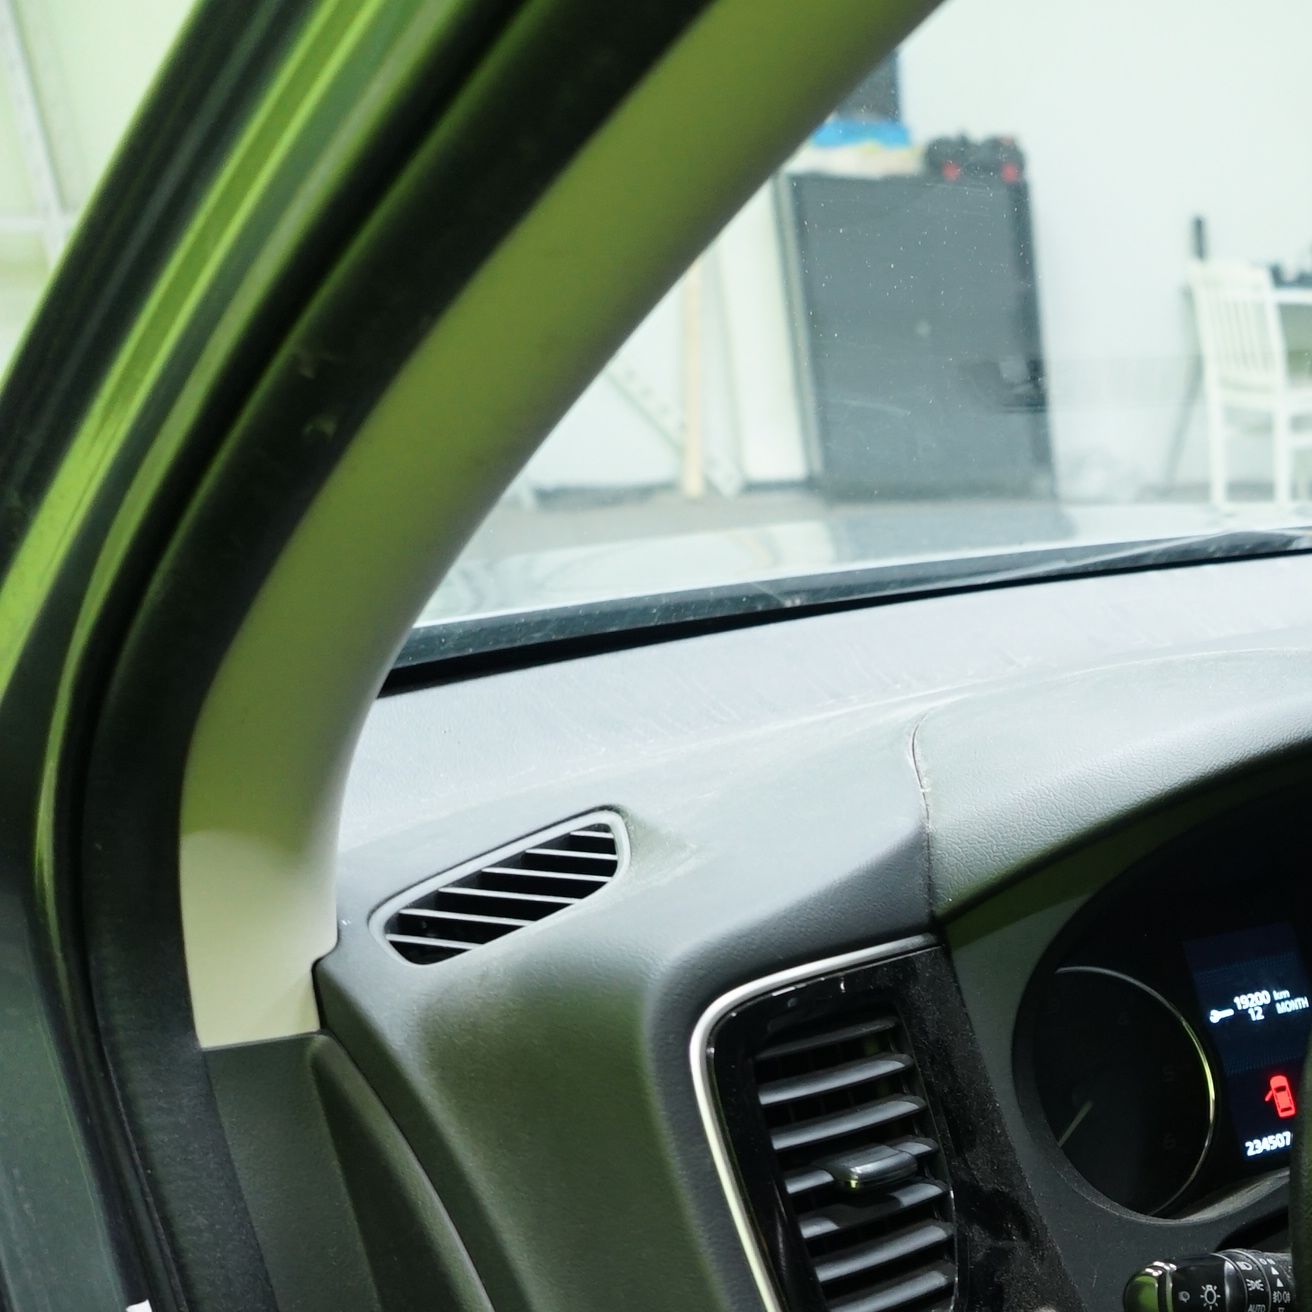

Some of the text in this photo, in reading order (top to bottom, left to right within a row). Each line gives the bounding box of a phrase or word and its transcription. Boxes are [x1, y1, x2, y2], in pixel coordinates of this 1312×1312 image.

[1233, 990, 1290, 1010] 19200 km
[1248, 996, 1309, 1021] 12 MONTH
[1244, 1130, 1292, 1156] 234507
